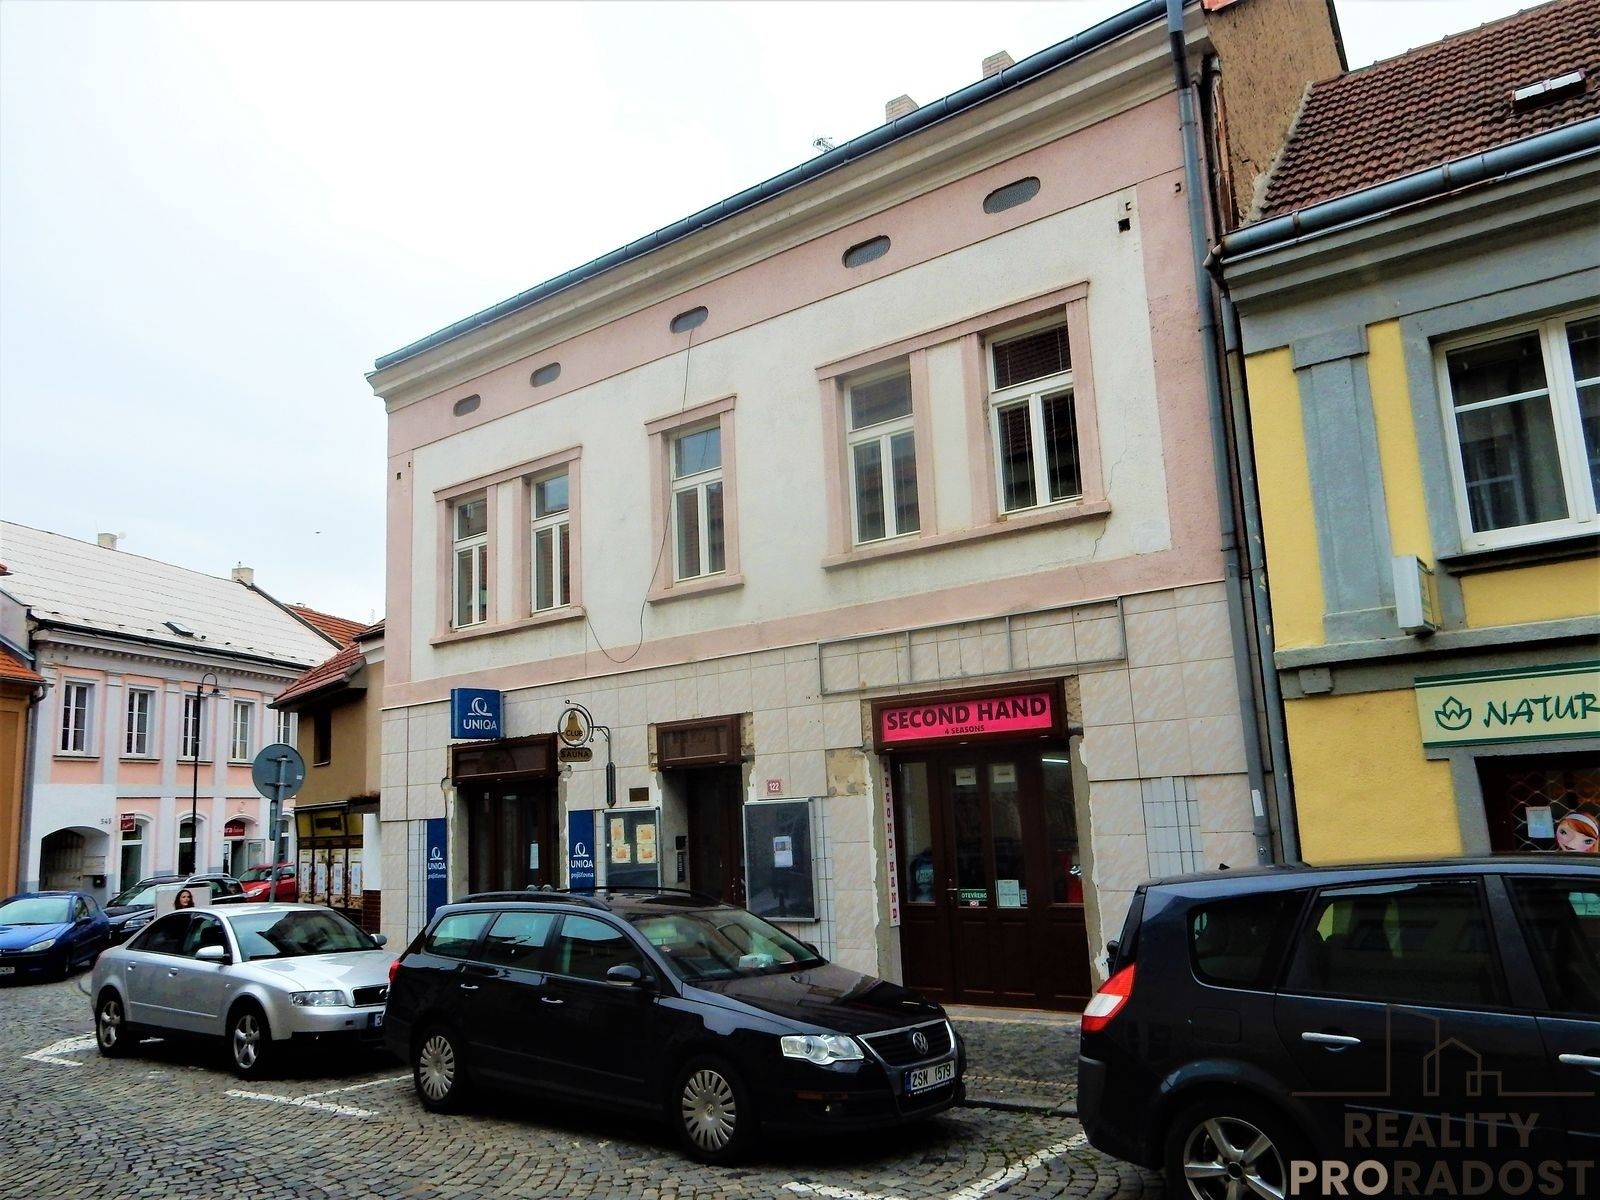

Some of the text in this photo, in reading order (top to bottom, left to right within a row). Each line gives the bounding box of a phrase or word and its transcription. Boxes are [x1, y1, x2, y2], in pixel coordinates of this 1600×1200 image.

[887, 697, 1047, 731] SECOND HAND
[463, 719, 498, 731] UNIQA
[565, 729, 583, 737] CLUB
[944, 725, 985, 735] 4 SEASONS
[560, 749, 590, 758] SAUNA
[768, 782, 780, 791] 122
[427, 862, 447, 870] UNIQA
[570, 859, 594, 868] UNIQA
